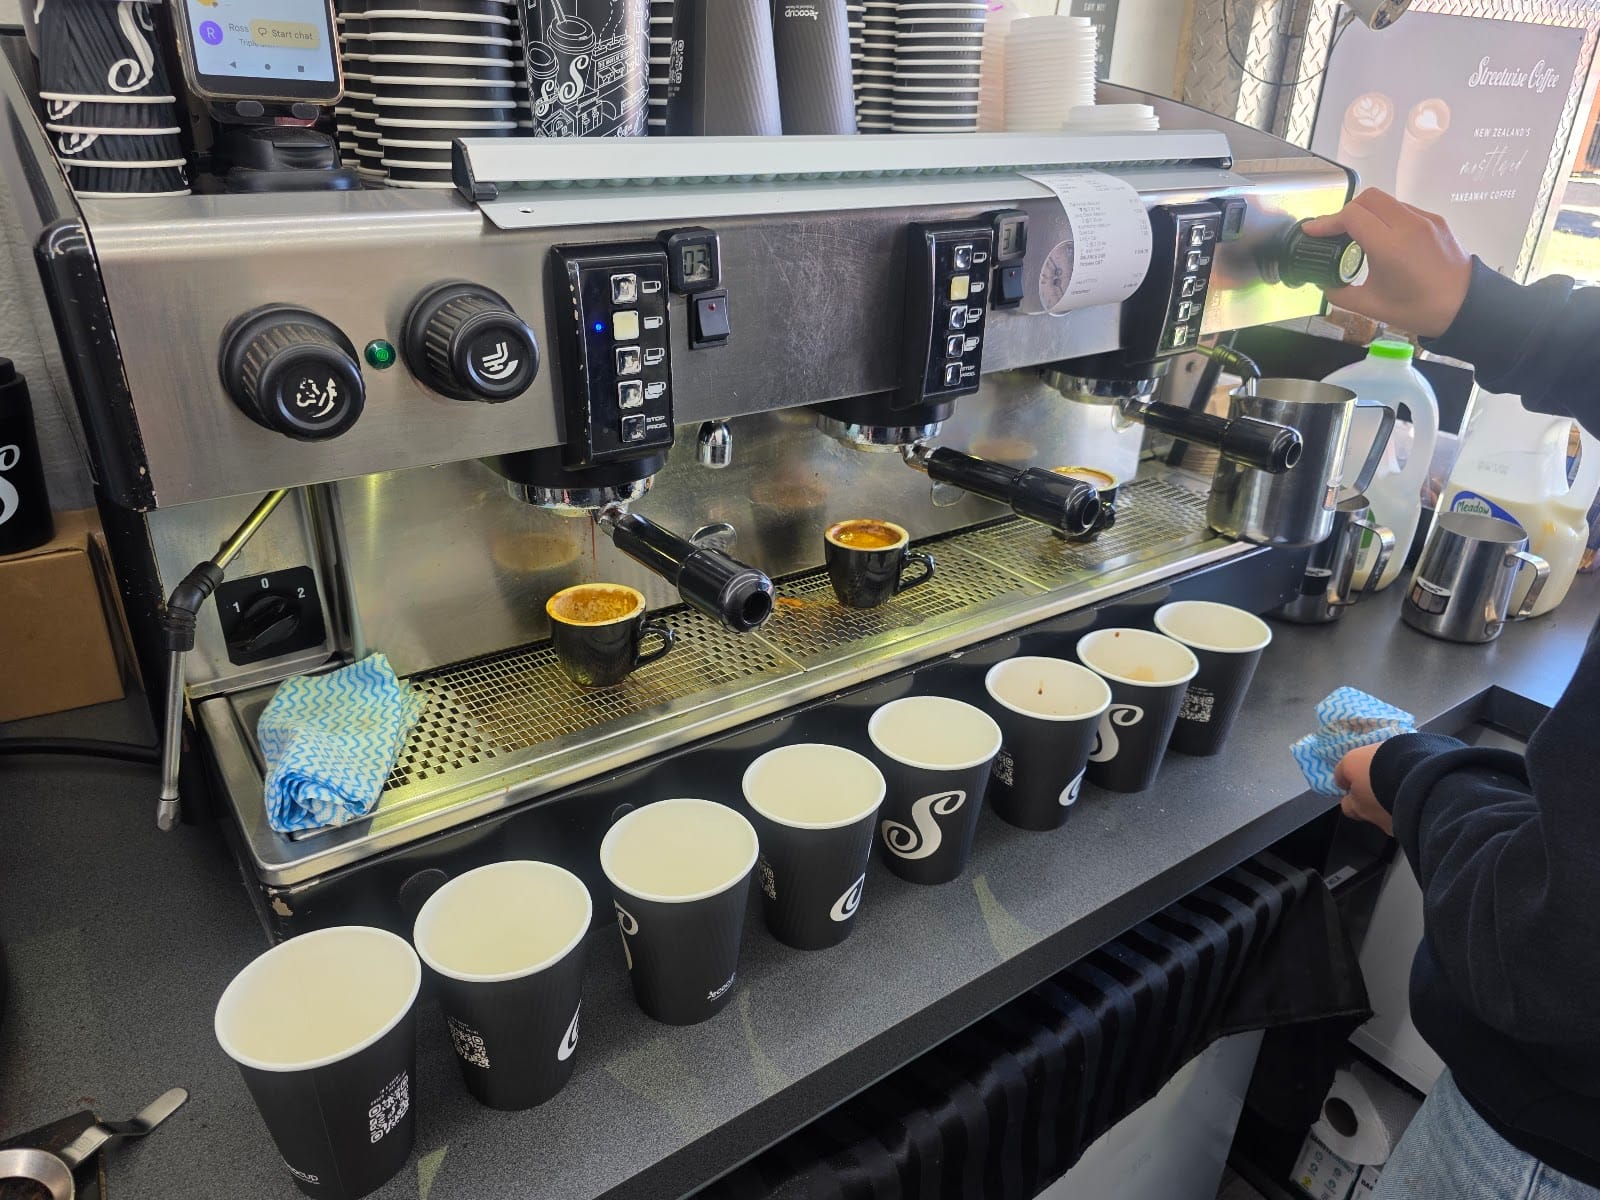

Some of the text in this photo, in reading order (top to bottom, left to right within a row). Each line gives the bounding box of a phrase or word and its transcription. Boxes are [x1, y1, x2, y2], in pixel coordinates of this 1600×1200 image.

[207, 27, 216, 40] R
[228, 23, 249, 33] Ross
[271, 29, 313, 40] Start chat
[1468, 56, 1560, 93] Streetwise Coffee
[1473, 127, 1531, 138] NEW ZEALAND'S
[1451, 189, 1517, 202] TAKEAWAY COFFEE
[1456, 500, 1490, 514] Meadow
[261, 578, 269, 589] 0
[297, 587, 306, 598] 2
[232, 601, 241, 613] 1
